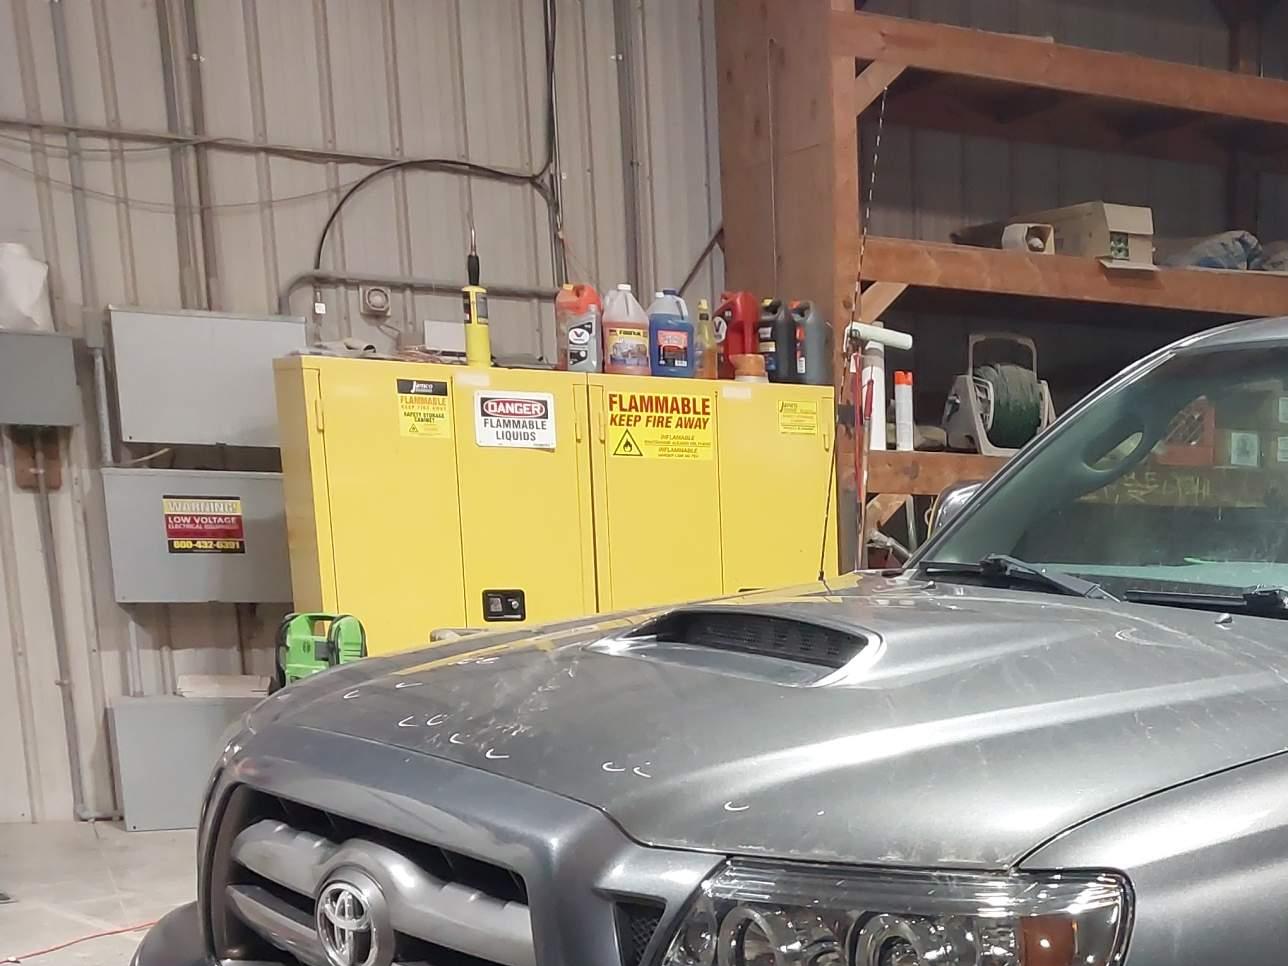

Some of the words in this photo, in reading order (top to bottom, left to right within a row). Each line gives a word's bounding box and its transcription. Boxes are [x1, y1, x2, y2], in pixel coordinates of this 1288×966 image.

[487, 401, 541, 415] DANGER
[608, 393, 711, 416] FLAMMABLE
[483, 418, 547, 430] FLAMMABLE
[609, 413, 641, 427] KEEP
[645, 415, 673, 429] FIRE
[675, 416, 710, 430] AWAY
[495, 430, 536, 441] LIQUIDS
[168, 516, 191, 524] LOW
[193, 516, 238, 524] VOLTAGE
